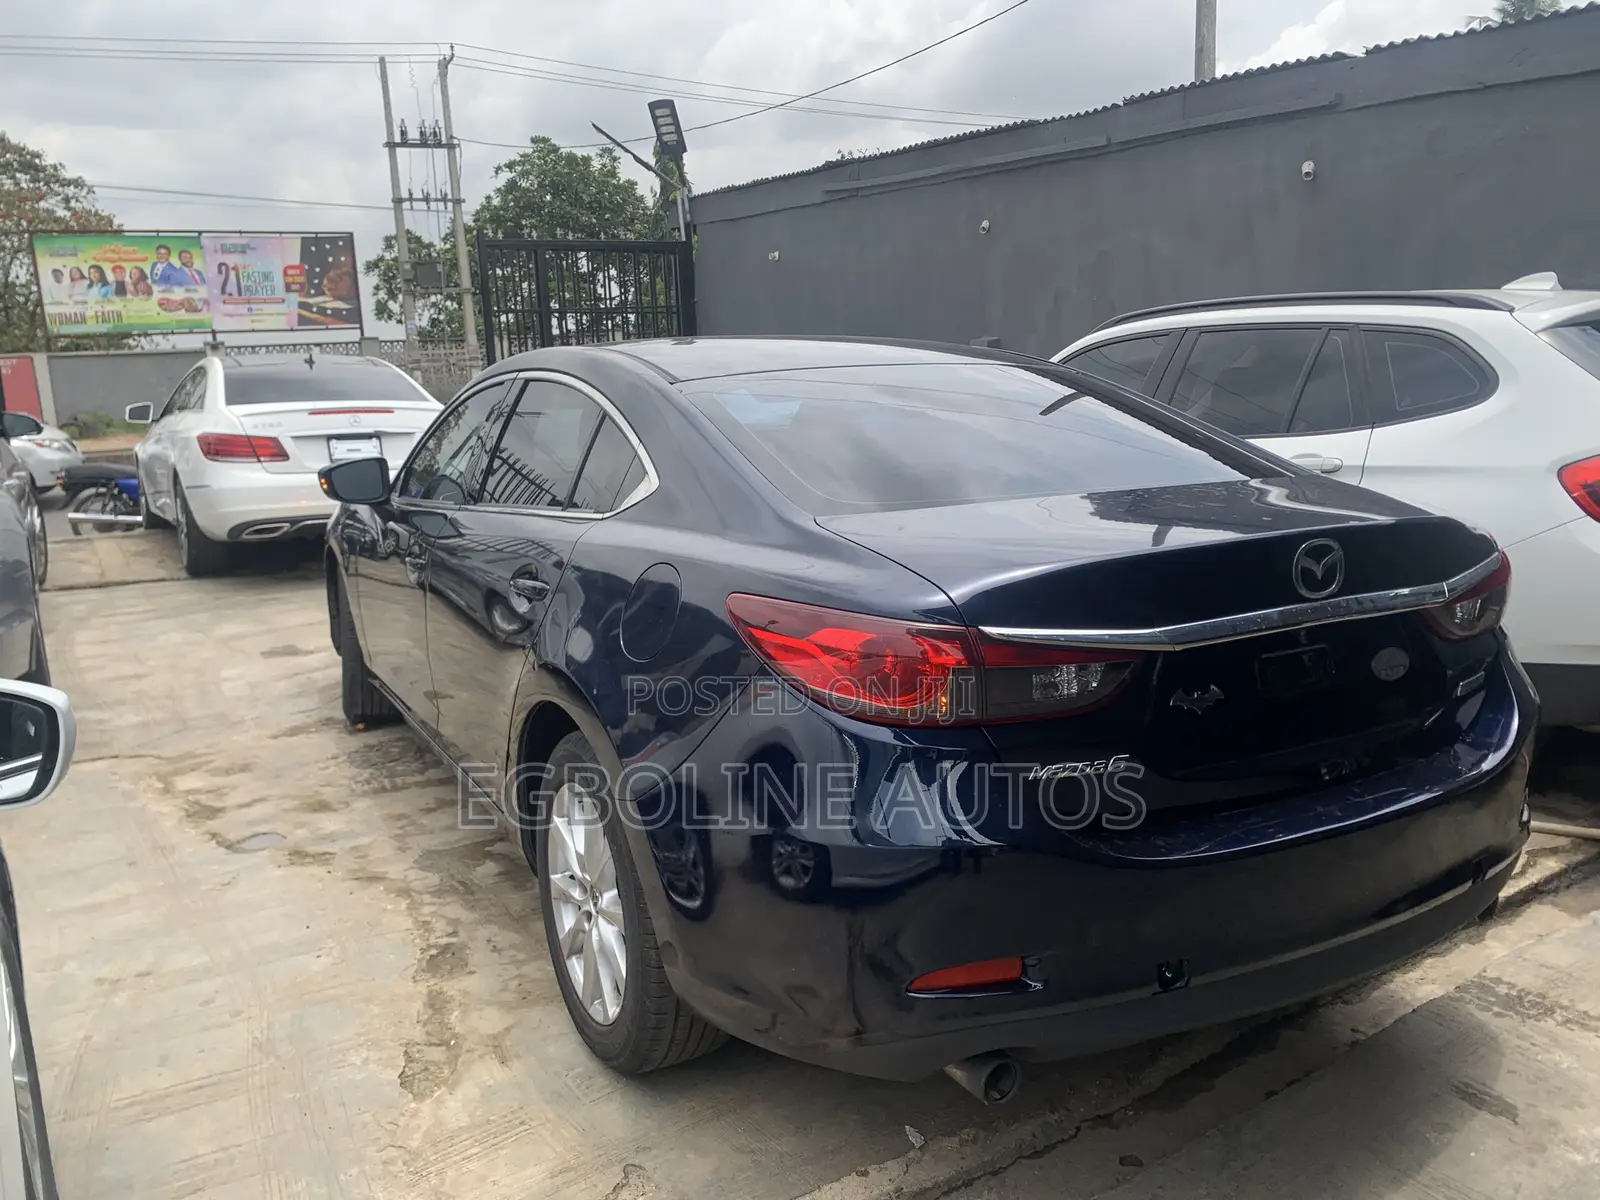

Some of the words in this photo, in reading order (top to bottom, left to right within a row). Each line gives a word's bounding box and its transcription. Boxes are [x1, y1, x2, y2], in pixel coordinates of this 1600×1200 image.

[217, 262, 243, 297] 21
[241, 271, 275, 283] FASTING
[243, 285, 276, 297] PRAYER
[47, 311, 87, 327] WOMAN
[95, 310, 123, 325] FAITH
